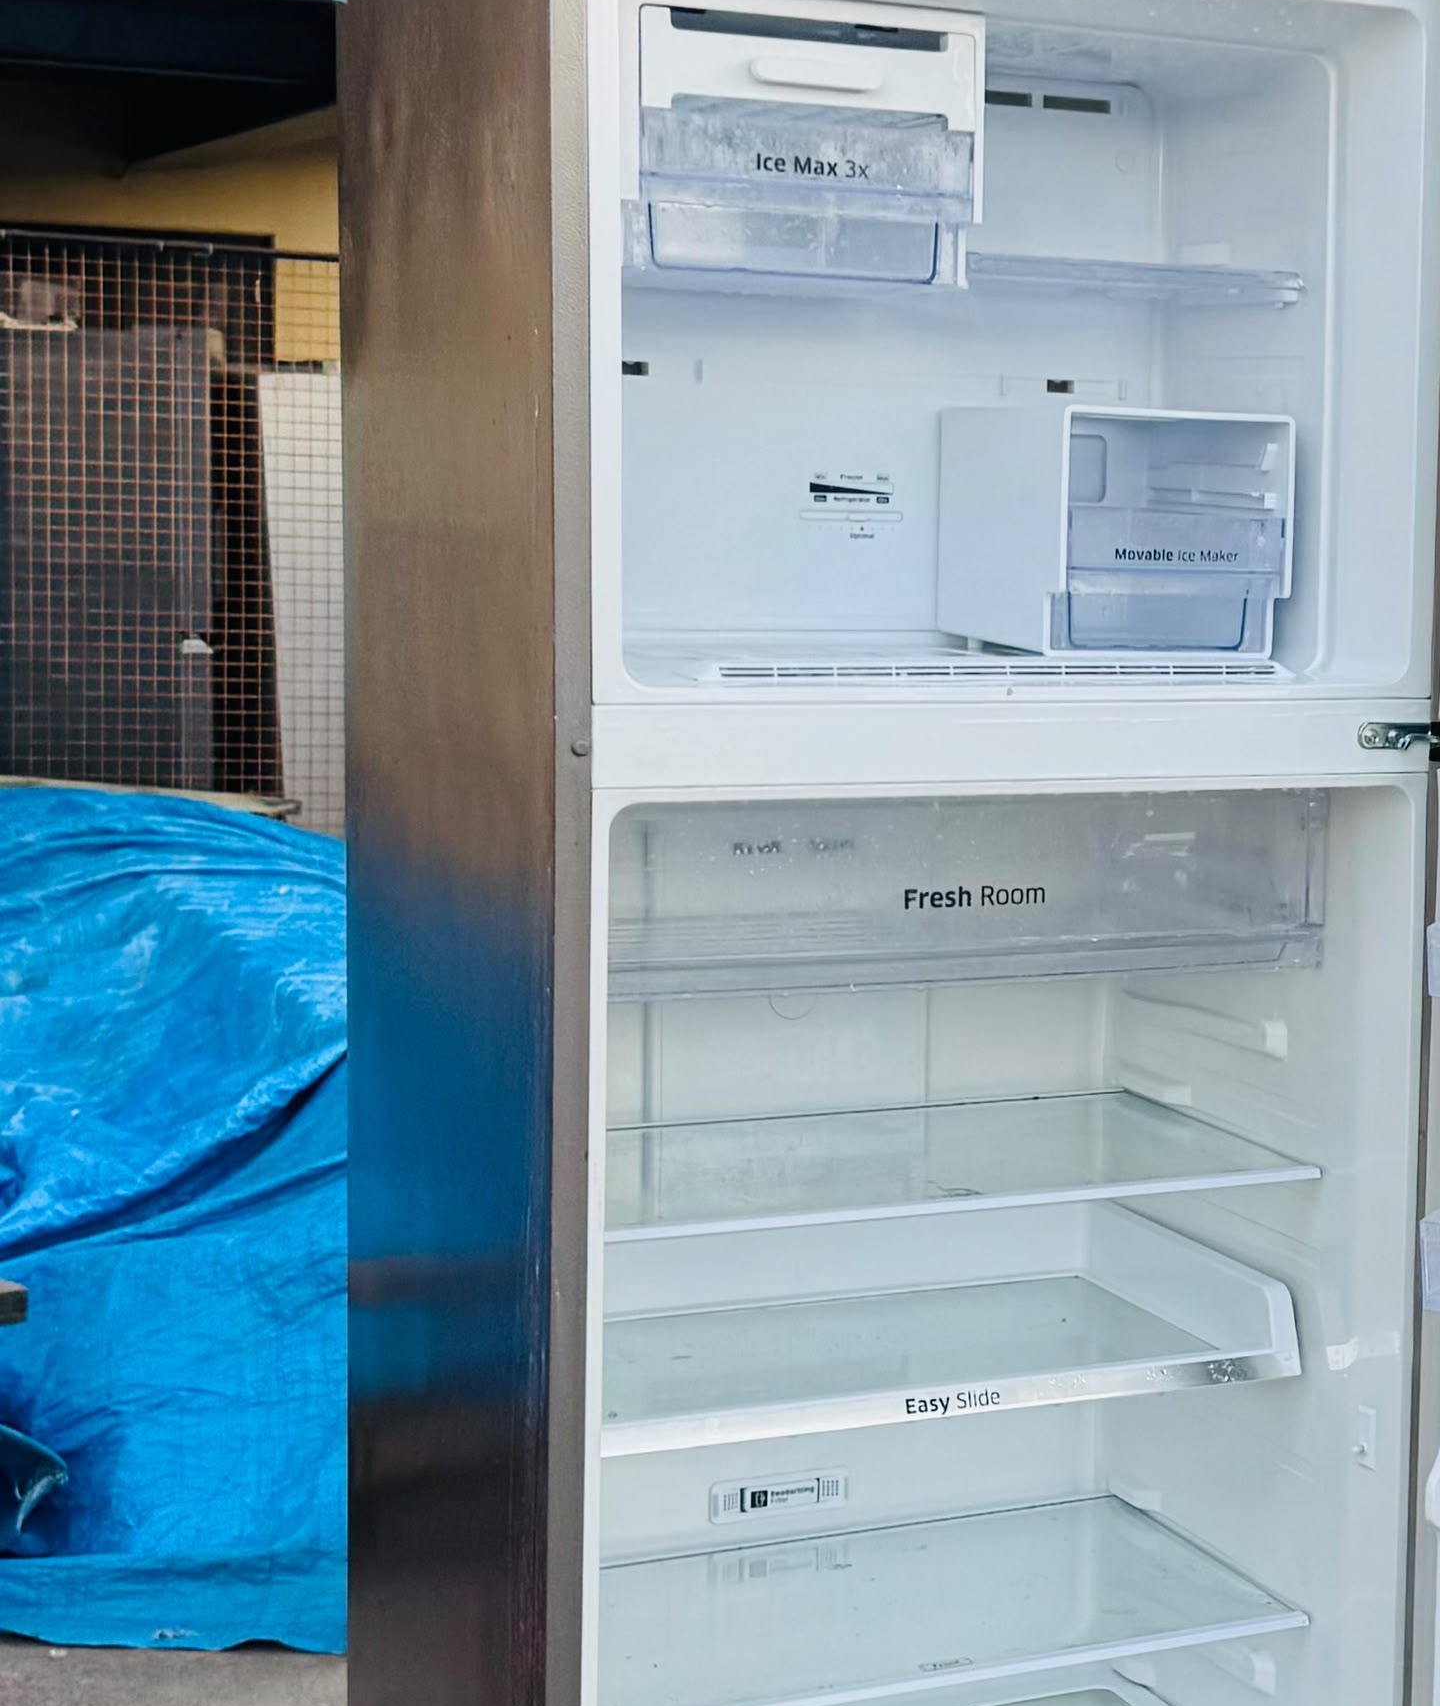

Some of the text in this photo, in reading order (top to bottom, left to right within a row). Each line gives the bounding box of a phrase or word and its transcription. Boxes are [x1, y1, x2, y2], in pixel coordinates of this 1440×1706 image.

[756, 152, 869, 180] Ice Max 3x
[1115, 547, 1239, 563] Movable Ice Maker
[904, 884, 1046, 910] Fresh Room
[905, 1388, 1001, 1415] Easy Slide
